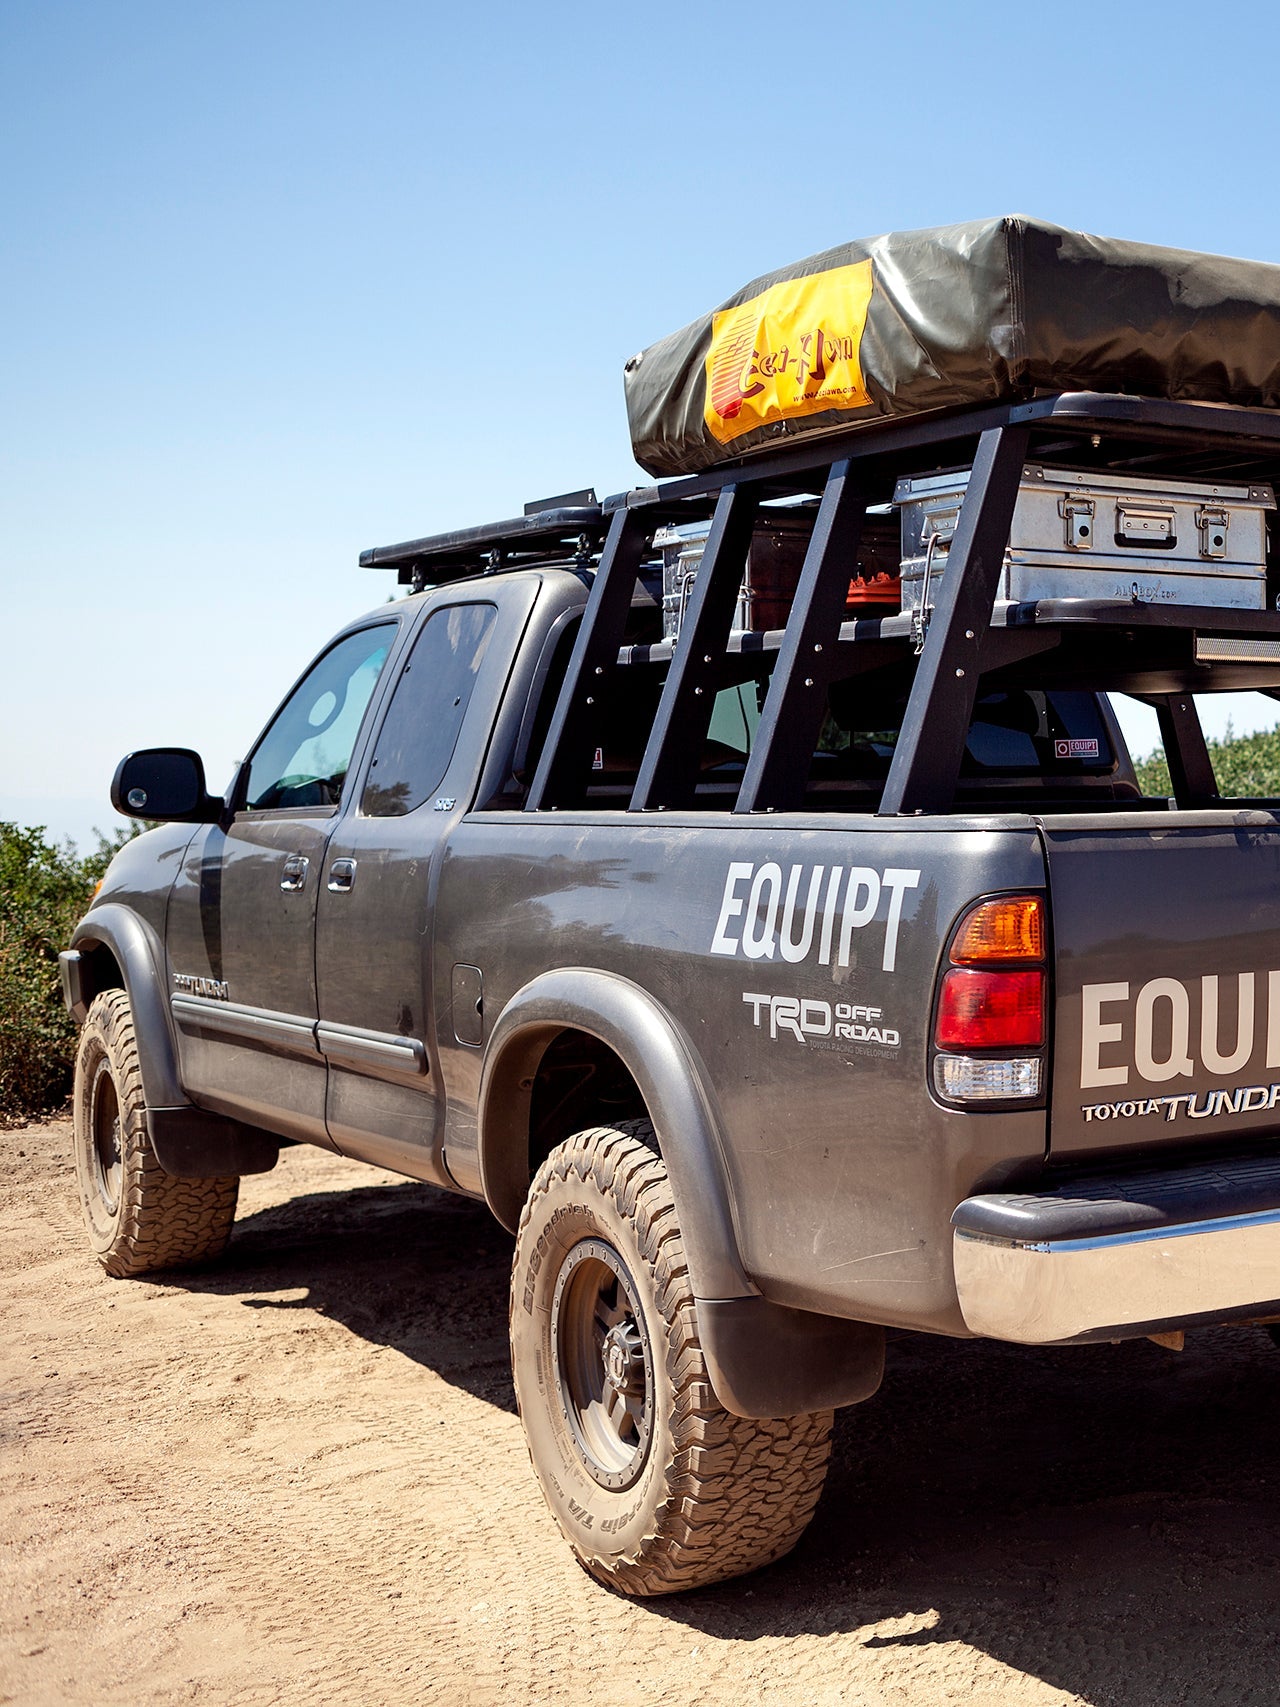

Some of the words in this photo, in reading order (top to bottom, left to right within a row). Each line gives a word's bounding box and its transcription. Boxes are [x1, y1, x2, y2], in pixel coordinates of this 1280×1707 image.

[738, 329, 853, 398] Eei-Awn
[1071, 741, 1096, 750] EQUIPT
[710, 862, 921, 972] EQUIPT
[742, 992, 833, 1043] TRD
[835, 1003, 883, 1022] OFF
[835, 1022, 901, 1048] ROAD
[809, 1039, 832, 1051] TOYOTA
[832, 1042, 855, 1054] RACING
[855, 1047, 898, 1061] DEVELOPMENT
[1082, 1099, 1160, 1122] TOYOTA
